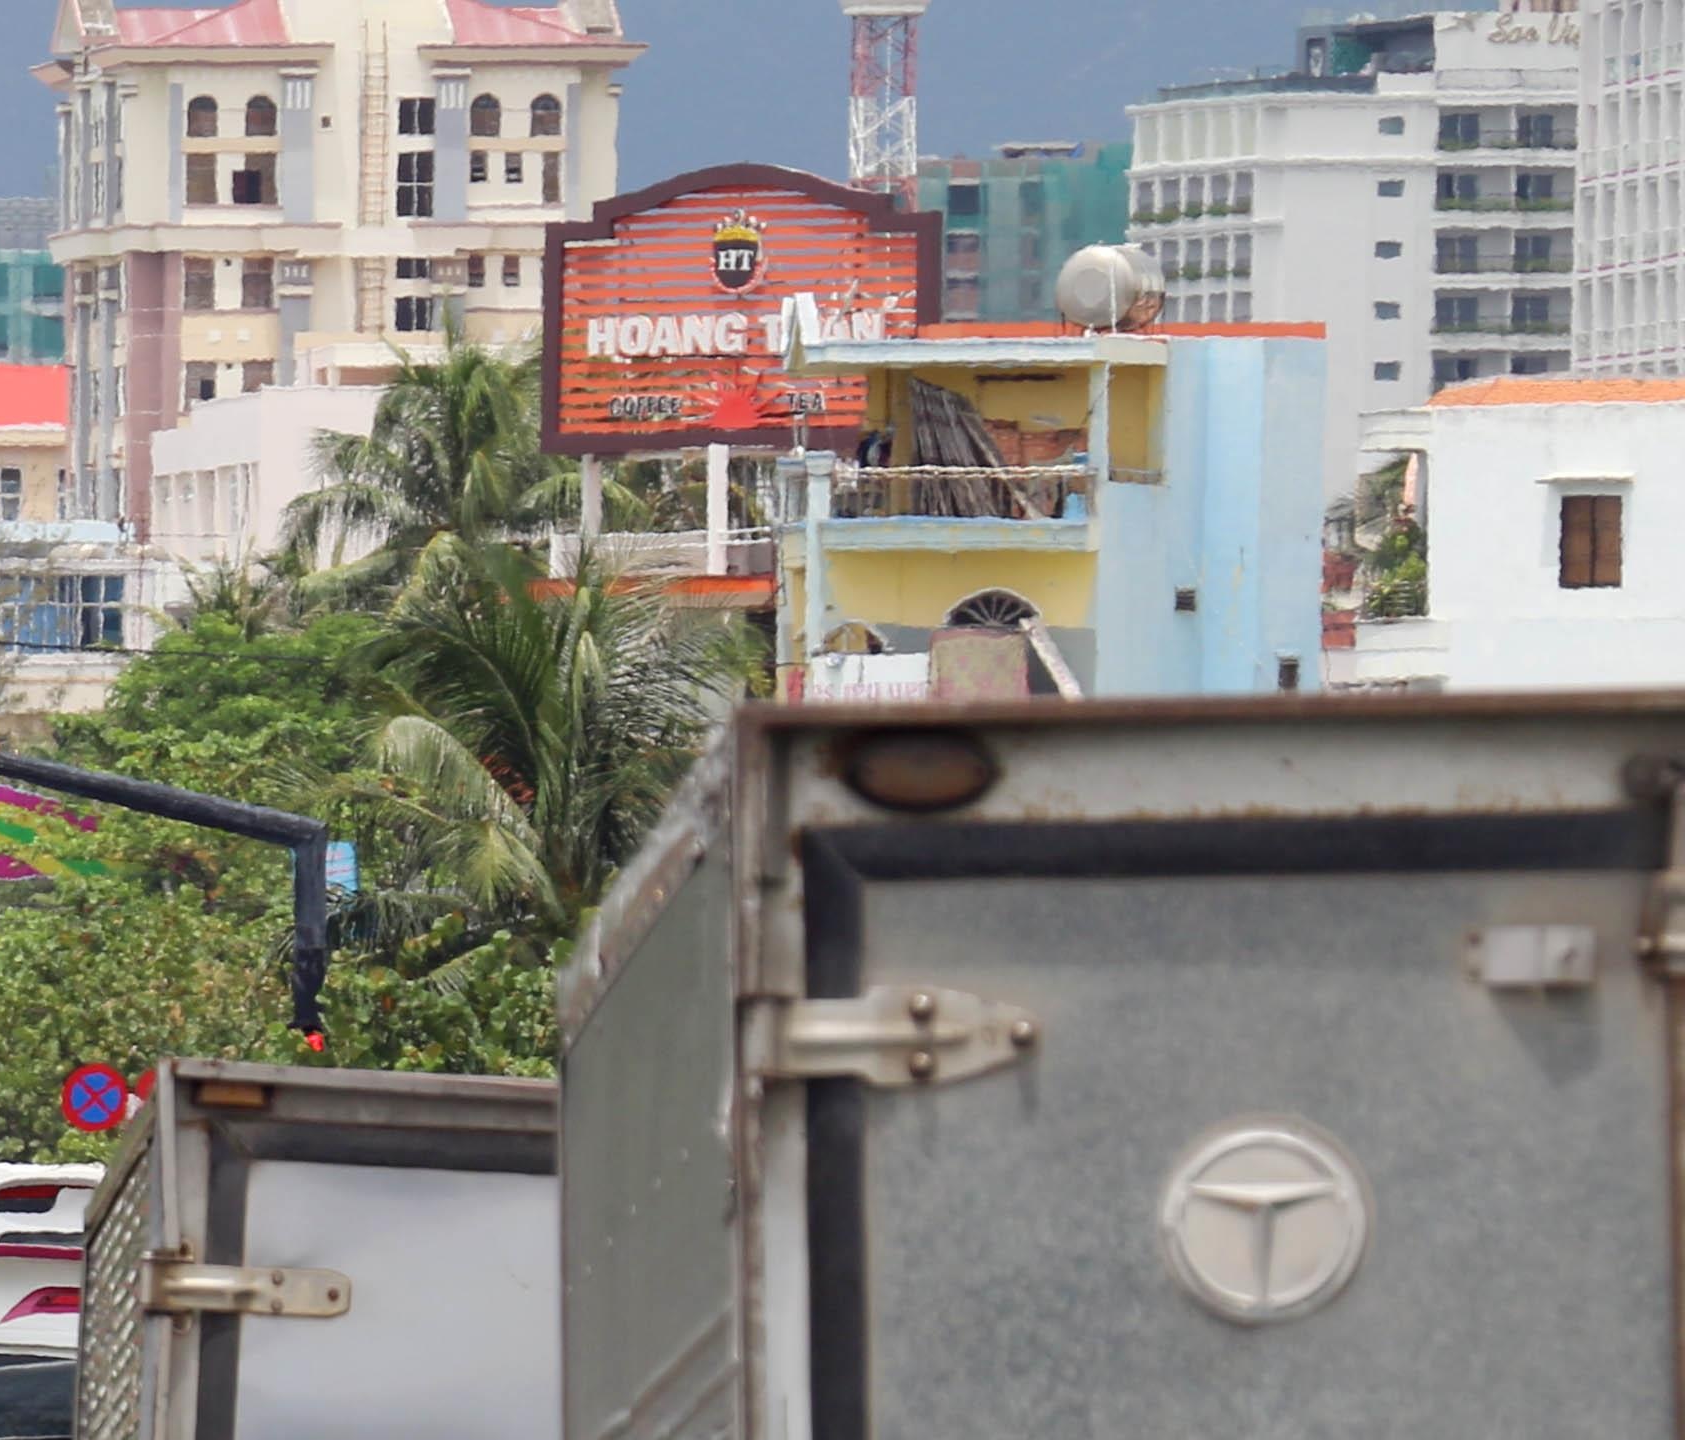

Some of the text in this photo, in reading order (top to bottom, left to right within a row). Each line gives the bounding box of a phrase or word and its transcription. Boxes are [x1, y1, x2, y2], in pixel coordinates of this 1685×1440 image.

[717, 248, 756, 272] HT
[588, 306, 887, 356] HOANG TAN
[610, 391, 825, 417] COFFEE TEA
